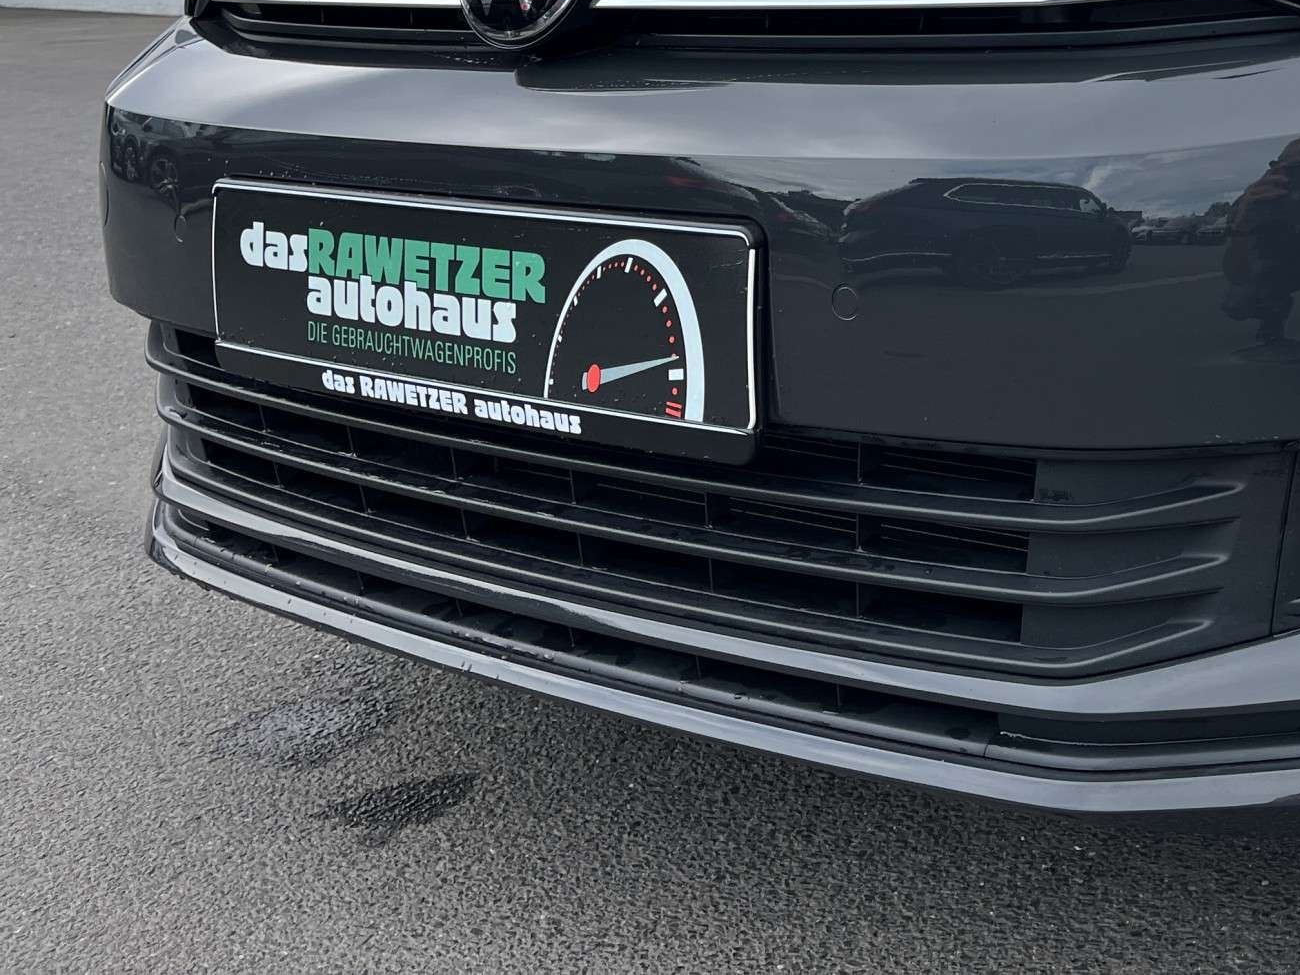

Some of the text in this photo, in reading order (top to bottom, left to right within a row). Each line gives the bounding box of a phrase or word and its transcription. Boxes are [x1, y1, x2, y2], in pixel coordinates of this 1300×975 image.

[307, 275, 517, 342] autohaus
[308, 322, 516, 374] DIE GEBRAUCHTWAGENPROFIS
[322, 370, 582, 434] das RAWETZER autohaus
